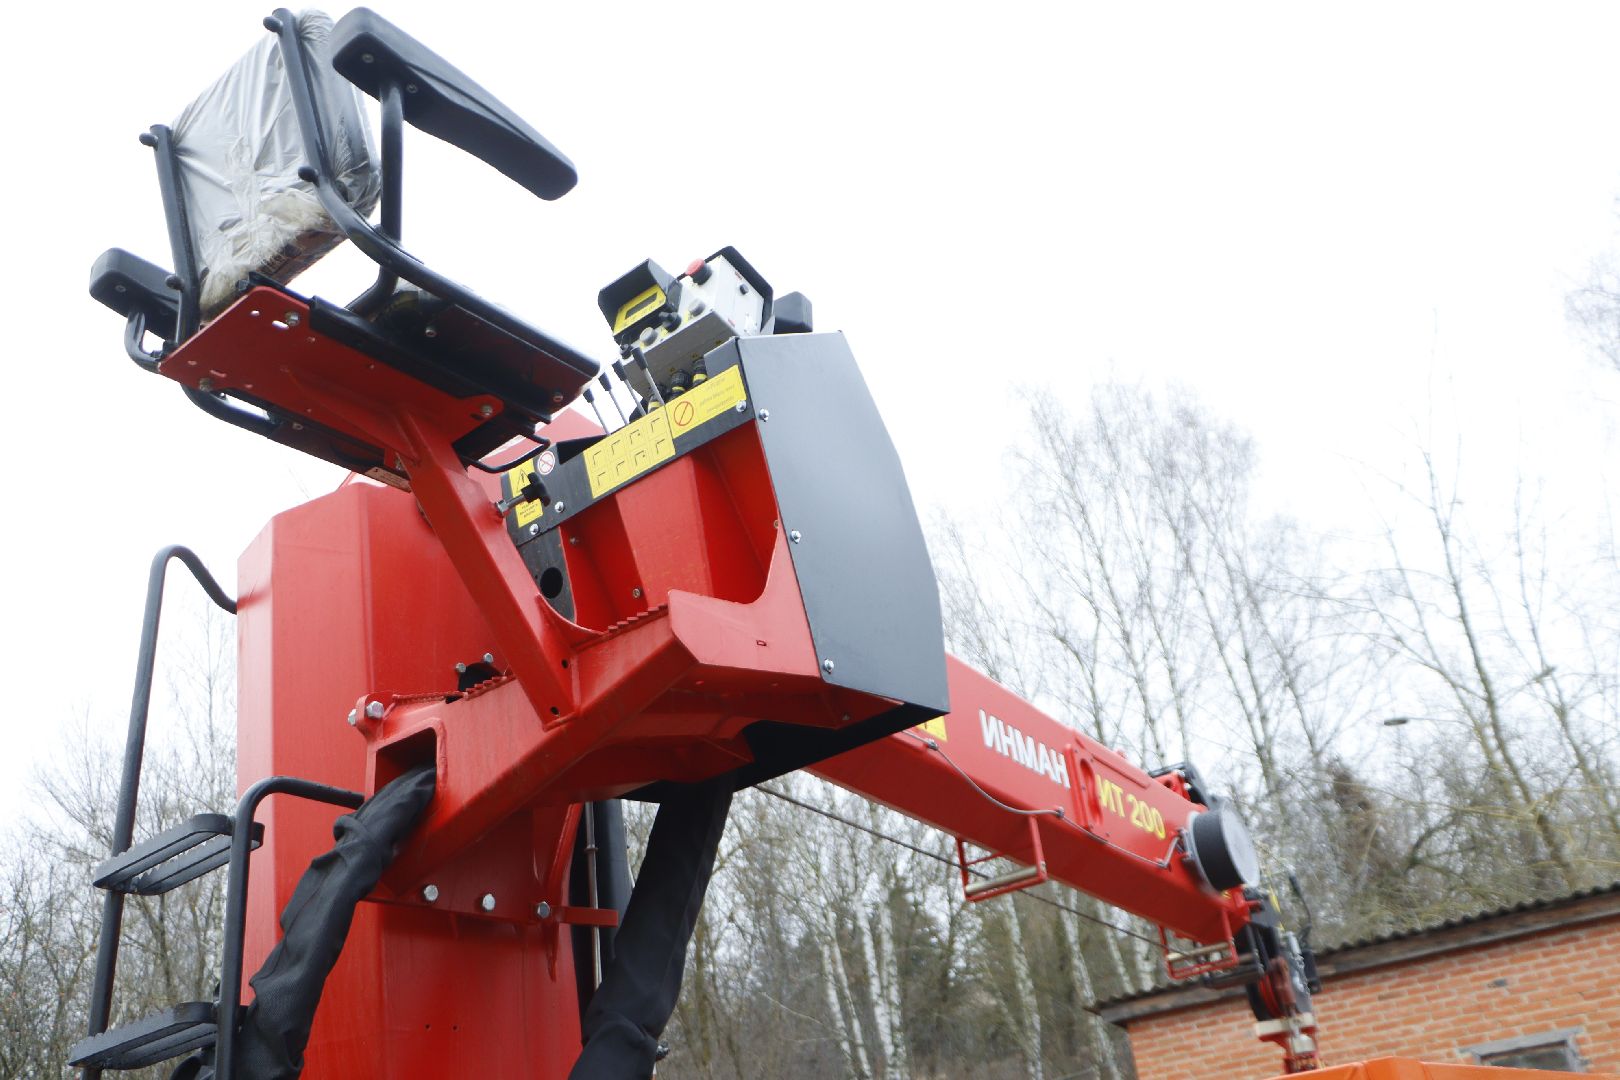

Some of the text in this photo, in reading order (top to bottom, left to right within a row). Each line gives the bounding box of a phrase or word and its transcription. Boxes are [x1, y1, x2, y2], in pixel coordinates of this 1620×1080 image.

[979, 708, 1070, 789] ИНМАН
[1096, 774, 1165, 839] ИТ 200
